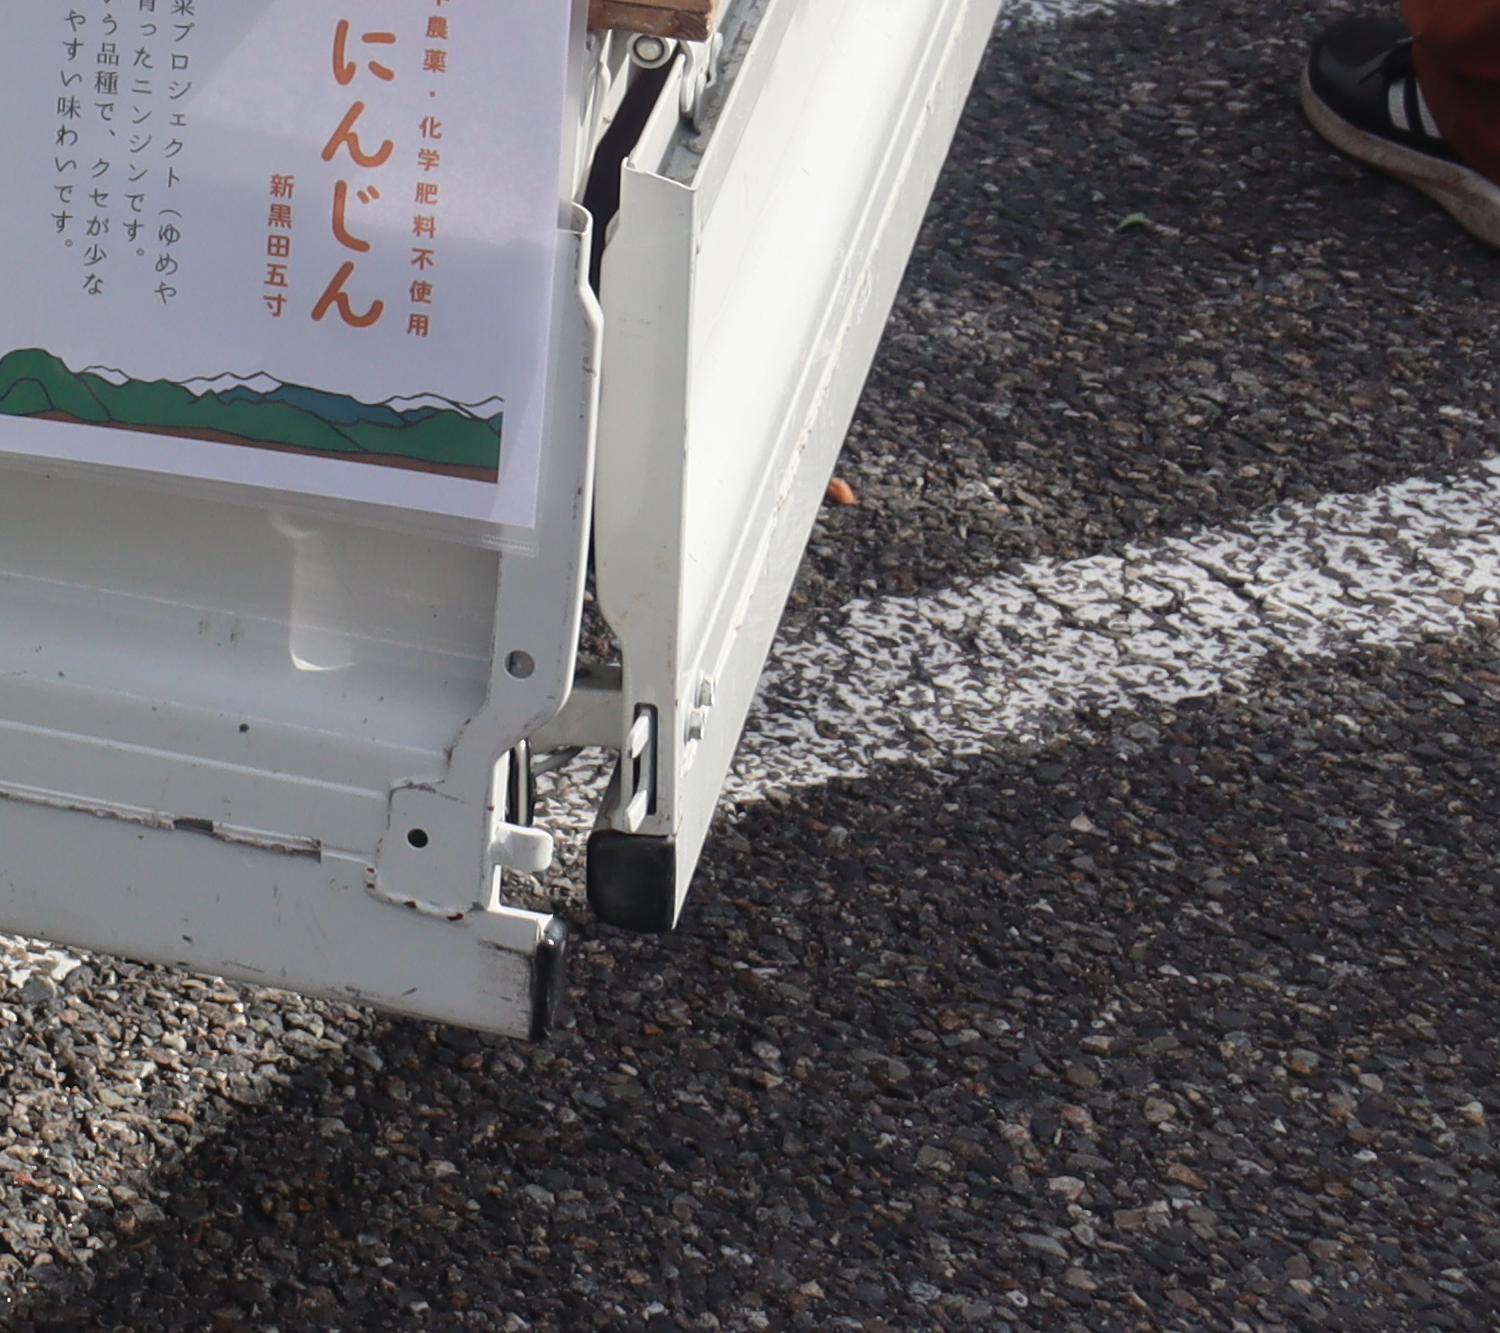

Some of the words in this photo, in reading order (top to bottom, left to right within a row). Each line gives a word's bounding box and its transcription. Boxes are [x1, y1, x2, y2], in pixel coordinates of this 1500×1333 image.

[262, 173, 295, 318] 新黒田五寸
